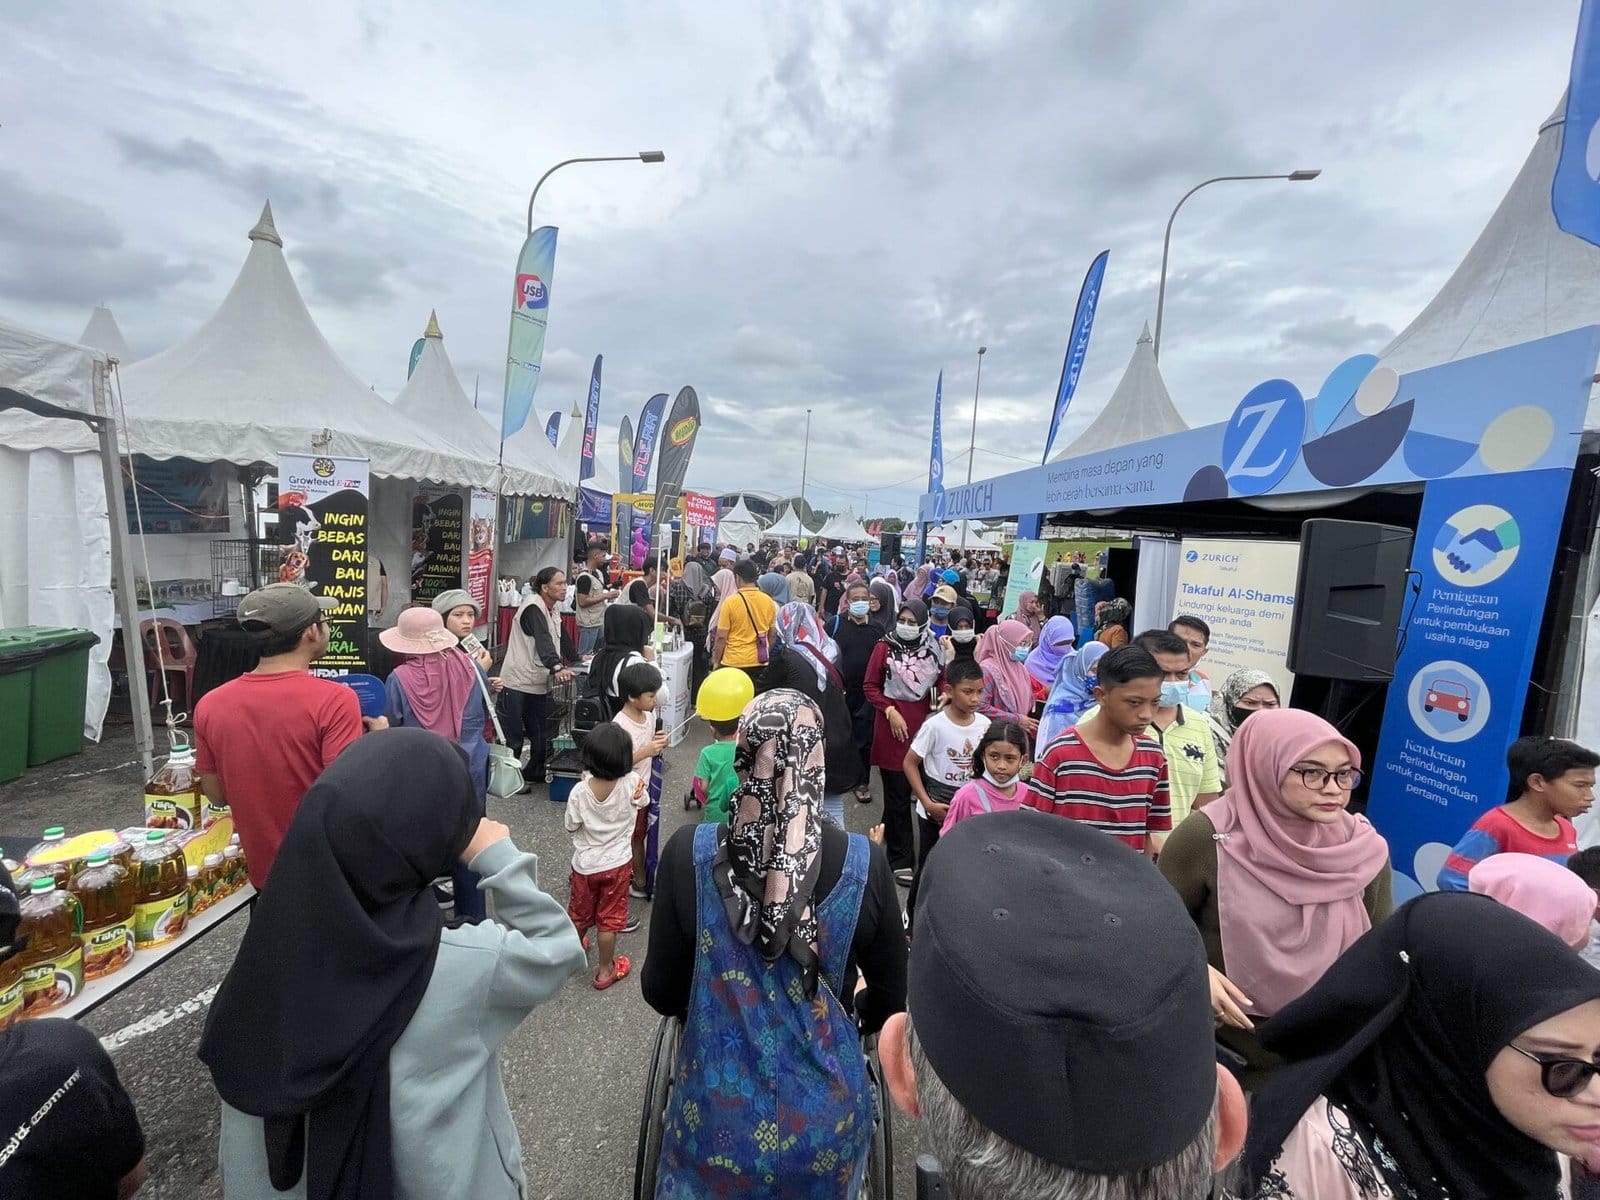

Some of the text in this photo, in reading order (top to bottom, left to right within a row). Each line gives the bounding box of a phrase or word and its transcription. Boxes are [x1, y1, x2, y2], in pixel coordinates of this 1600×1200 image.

[522, 285, 543, 298] USB
[1225, 398, 1287, 478] Z
[1048, 453, 1164, 484] Membina masa depan yang
[288, 475, 335, 487] Growfeed
[949, 483, 993, 516] ZURICH
[1062, 485, 1085, 501] cerah
[688, 501, 715, 513] TESTING
[691, 496, 711, 506] FOOD
[324, 512, 364, 527] INGIN
[438, 507, 461, 517] INGIN
[434, 519, 461, 529] BEBAS
[317, 530, 364, 545] BEBAS
[441, 531, 461, 540] DARI
[443, 543, 461, 551] BAU
[331, 549, 364, 564] DARI
[436, 554, 461, 562] NAJIS
[1202, 553, 1239, 563] ZURICH
[335, 567, 365, 581] BAU
[428, 564, 461, 574] HAIWAN
[323, 585, 365, 598] NAJIS
[1182, 583, 1295, 605] Takaful Al-Shams
[1178, 599, 1285, 620] Lindungi keluarga demi
[1427, 602, 1499, 620] Perlindungan
[1229, 617, 1252, 628] anda
[1413, 616, 1510, 636] untuk pembukaan
[1425, 632, 1490, 650] usaha niaga
[1404, 739, 1466, 768] Kenderaan
[1399, 752, 1467, 784] Perlindungan
[1386, 762, 1478, 803] untuk pemanduan
[1406, 784, 1448, 806] pertama
